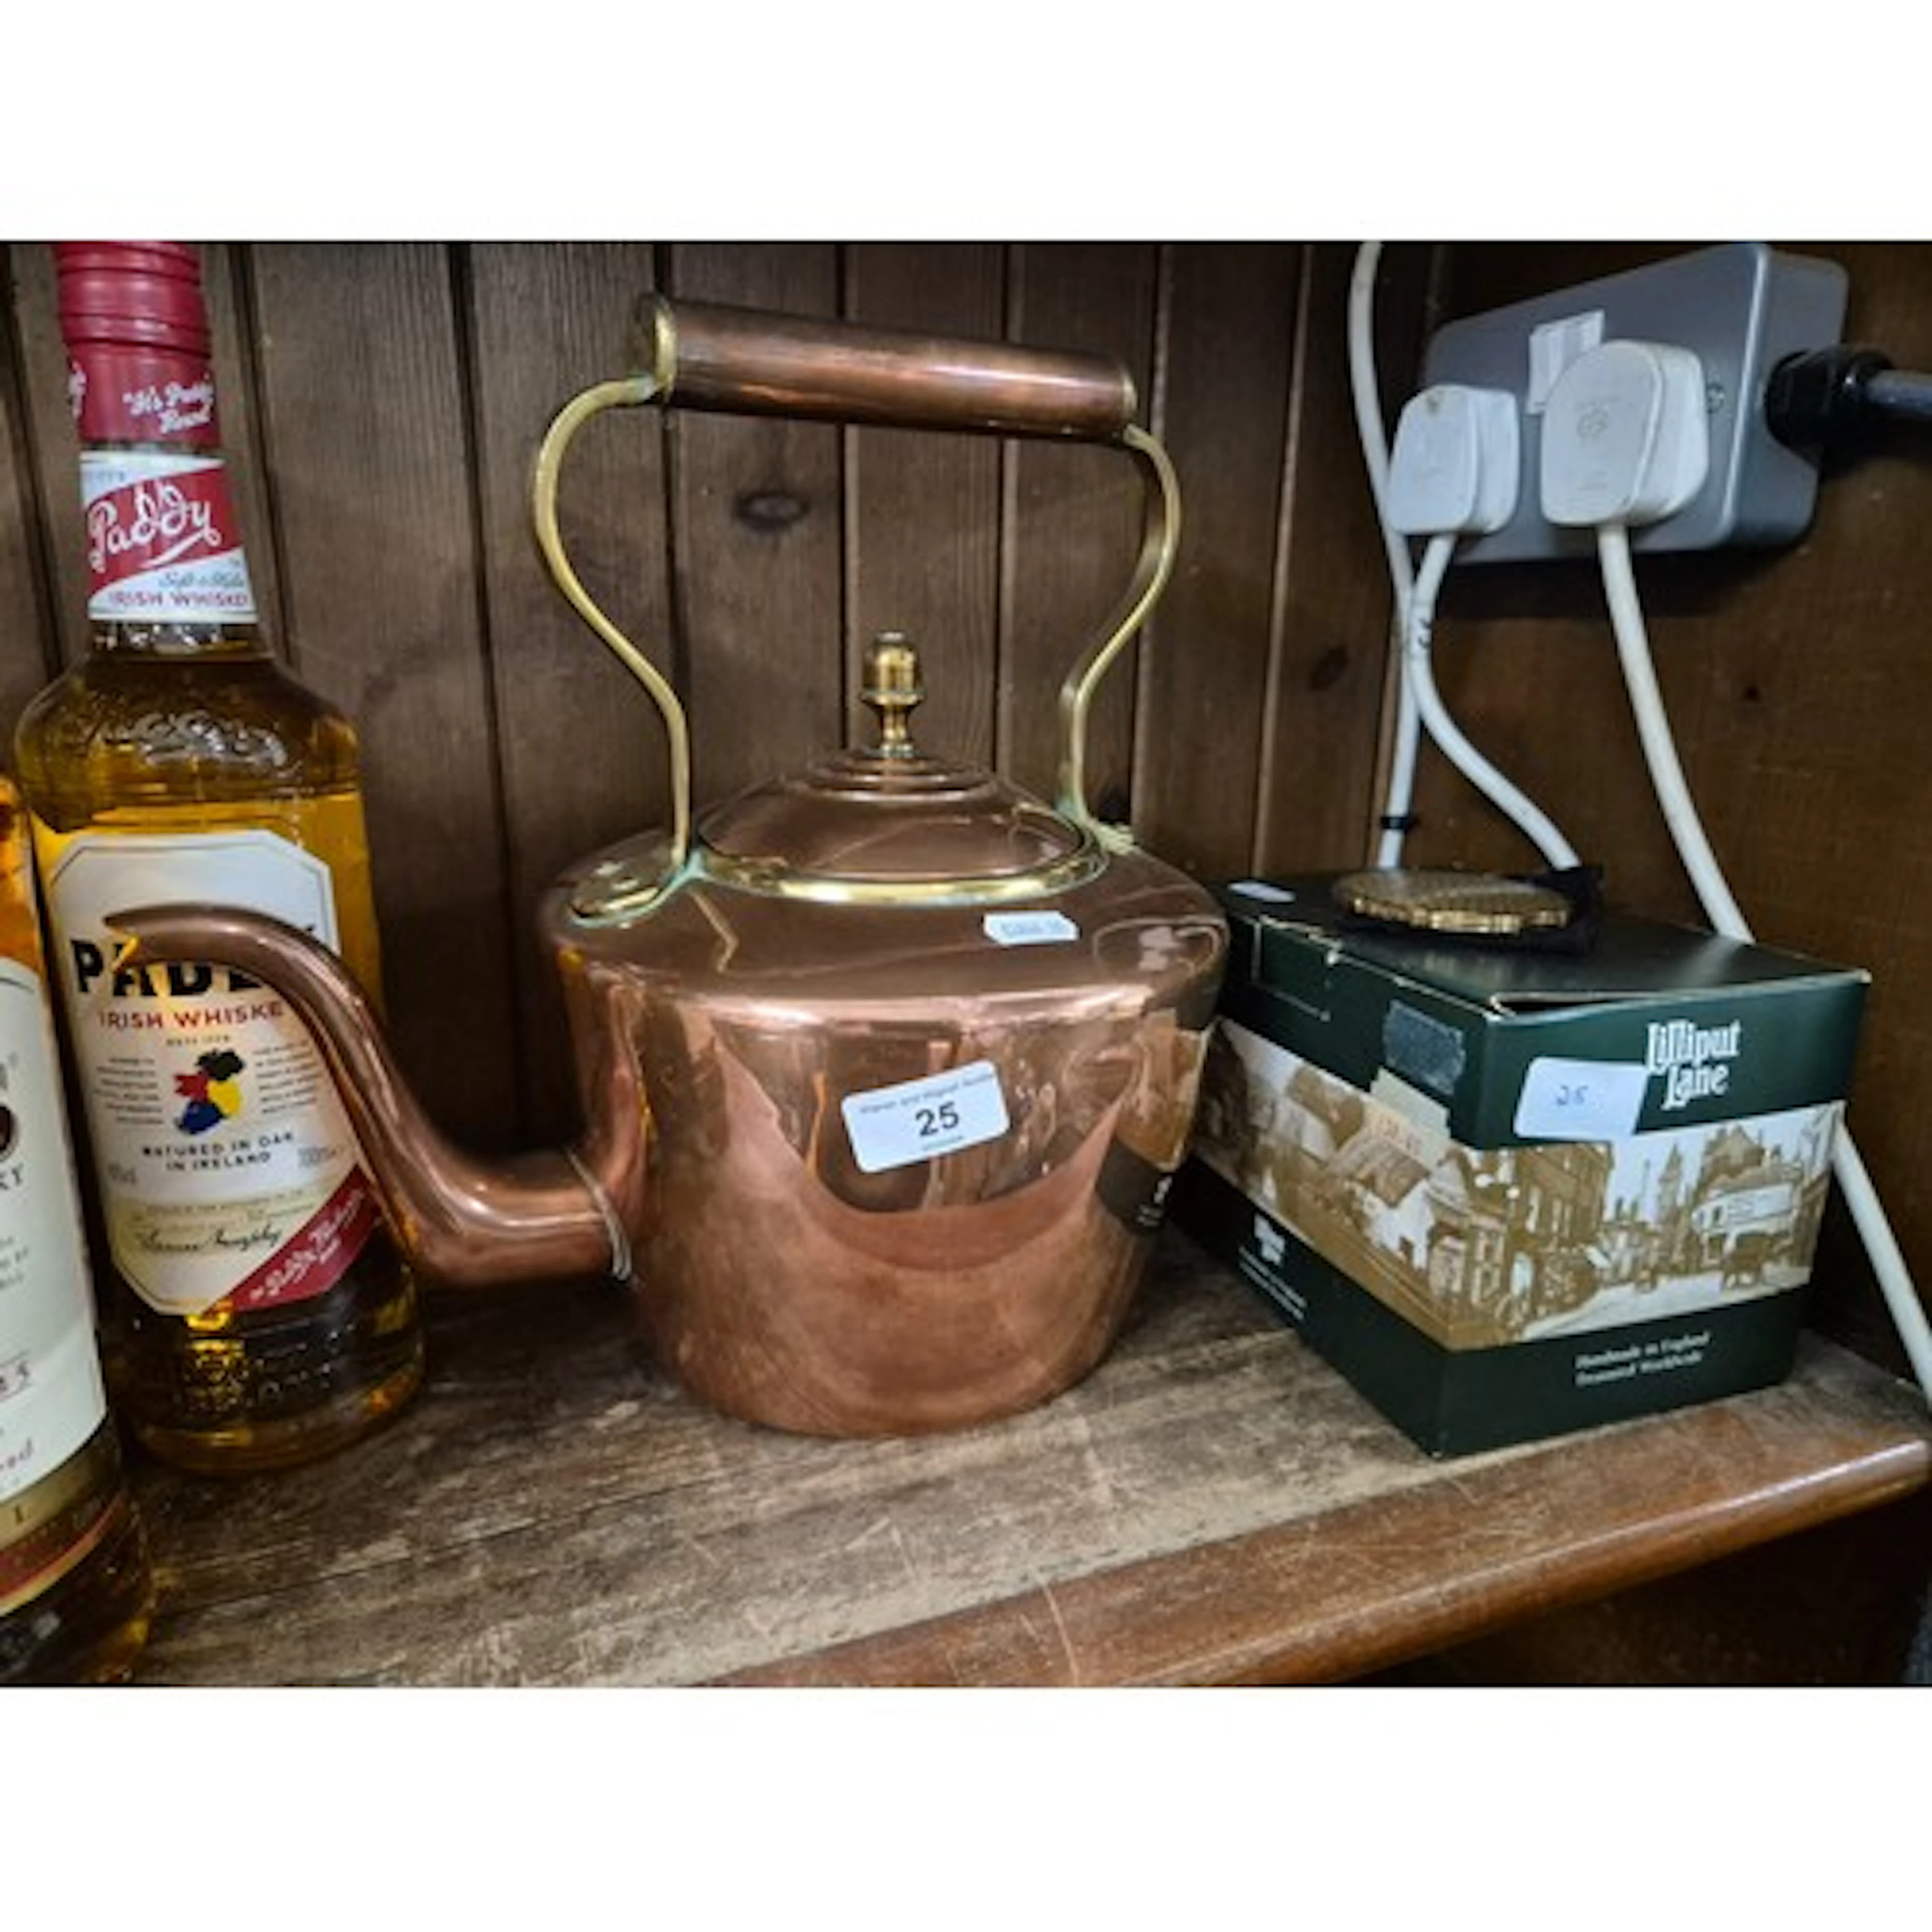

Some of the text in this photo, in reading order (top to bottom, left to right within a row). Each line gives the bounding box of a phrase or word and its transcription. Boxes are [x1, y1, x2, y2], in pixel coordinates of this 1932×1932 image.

[88, 479, 222, 574] Paddy
[100, 1001, 284, 1029] IRISH WHISKE
[1646, 1018, 1742, 1075] Lilliput
[1661, 1063, 1730, 1110] Lane
[915, 1101, 959, 1137] 25
[142, 1131, 294, 1158] MATURED IN OAK
[166, 1152, 271, 1171] IN IRELAND
